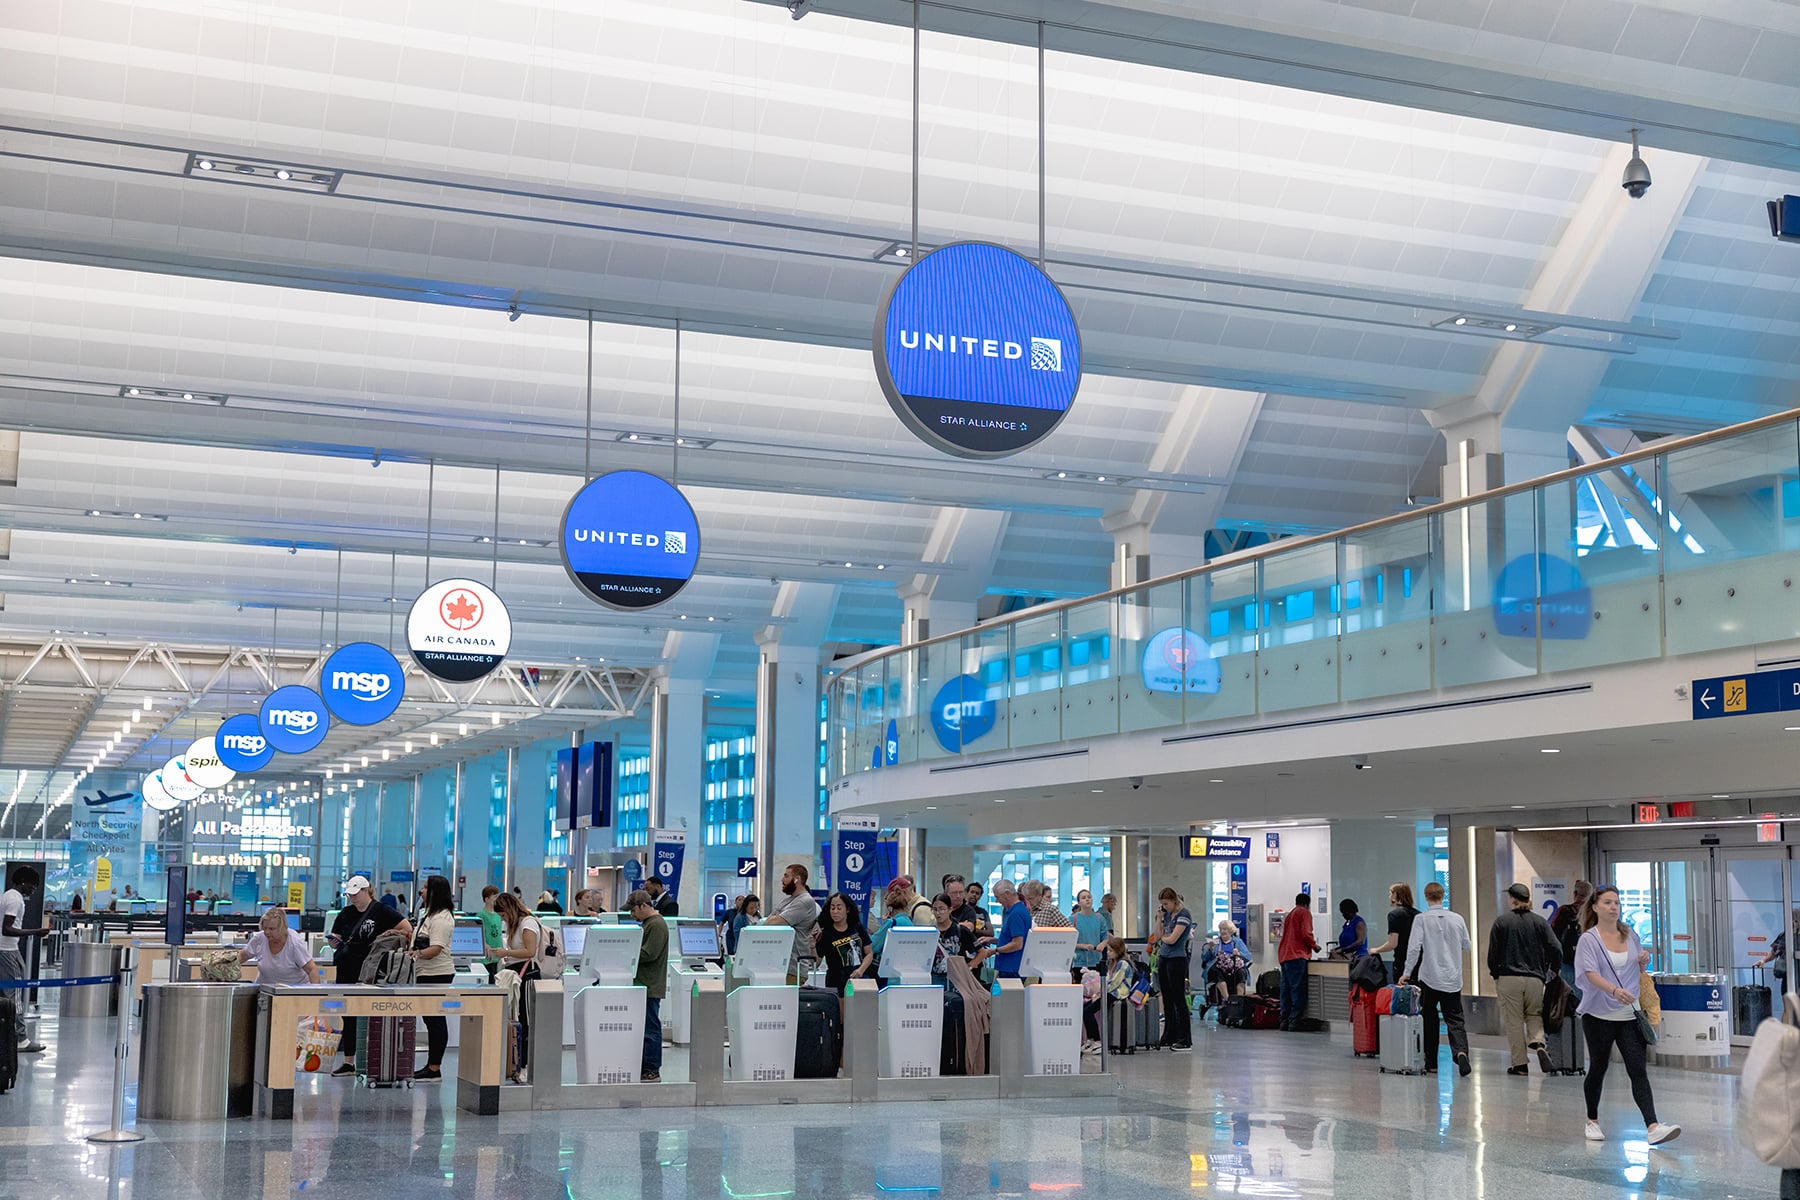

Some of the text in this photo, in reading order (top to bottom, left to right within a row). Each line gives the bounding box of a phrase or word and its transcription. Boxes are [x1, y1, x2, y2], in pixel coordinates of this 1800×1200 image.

[900, 330, 1022, 359] UNITED
[940, 415, 1016, 431] STAR ALLIANCE
[574, 528, 659, 547] UNITED
[600, 583, 654, 593] STAR ALLIANCE
[424, 635, 496, 646] AIR CANADA
[425, 652, 484, 662] STAR ALLIANCE
[332, 671, 391, 696] msp
[269, 709, 319, 730] msp
[223, 735, 266, 752] msp
[1639, 805, 1657, 822] EXIT
[75, 820, 138, 831] North Security
[192, 821, 217, 835] All
[82, 831, 130, 841] Checkpoint
[87, 844, 98, 853] All
[844, 840, 865, 851] Step
[1209, 838, 1247, 848] Accessibility
[658, 850, 675, 859] Step
[1209, 848, 1242, 856] Assistance
[192, 852, 311, 867] Less than 10 min
[844, 880, 861, 890] Tag
[1542, 899, 1558, 925] 2
[372, 1002, 413, 1011] REPACK
[306, 1043, 337, 1057] ORAN
